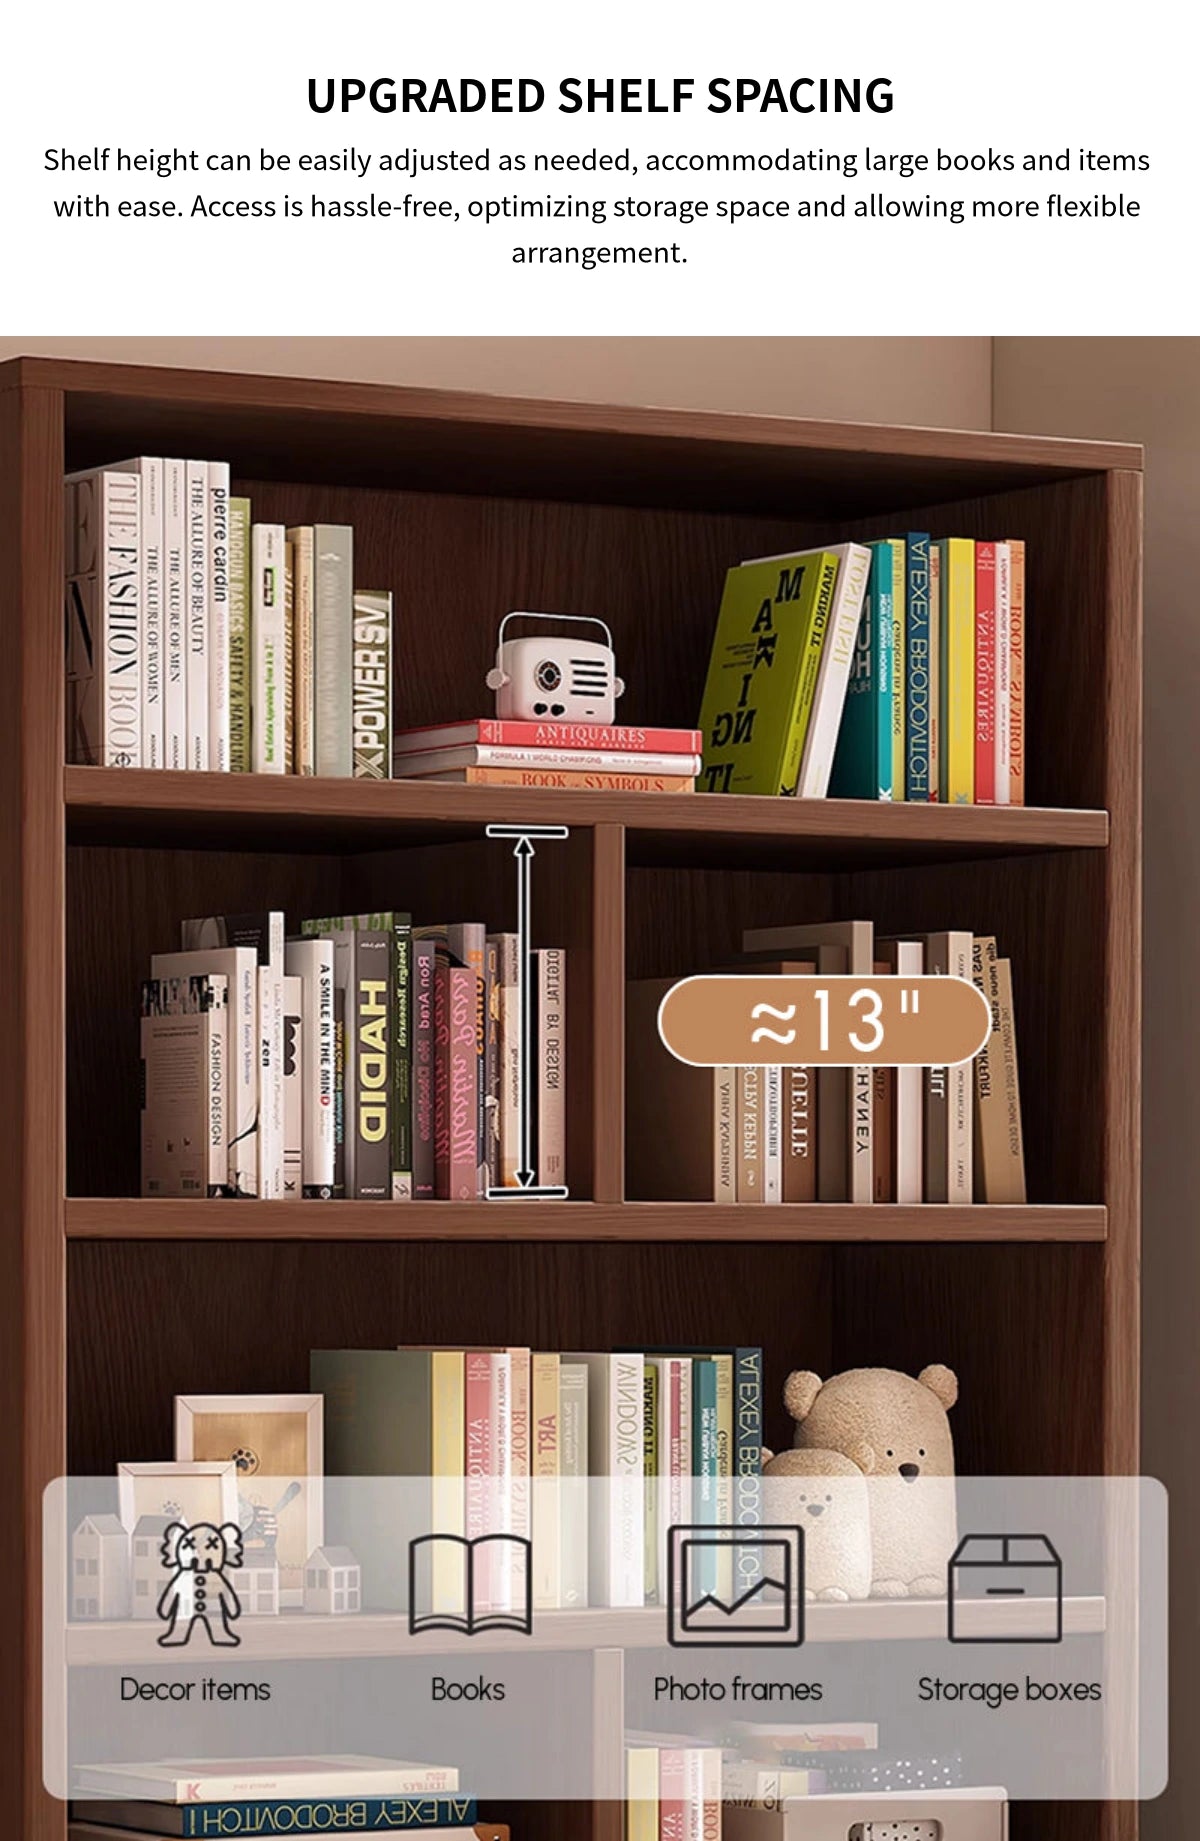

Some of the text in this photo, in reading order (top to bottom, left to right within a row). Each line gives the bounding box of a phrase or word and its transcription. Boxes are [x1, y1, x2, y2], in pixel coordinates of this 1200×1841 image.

[108, 477, 138, 538] THE
[191, 478, 204, 655] THE ALLURE OF BEAUTY
[212, 488, 228, 602] pierre cardin
[230, 511, 244, 581] HANDGUN
[108, 547, 138, 674] FASHION
[147, 546, 159, 704] THE ALLURE OF WOMEN
[169, 548, 181, 682] THE ALLURE OF MEN
[230, 584, 244, 633] BASICS
[230, 636, 244, 686] SAFETY
[490, 753, 525, 761] FORMULA
[533, 754, 559, 763] WORLD
[535, 725, 646, 743] ANTIQUAIRES
[522, 773, 665, 792] BOOK SYMBOLS
[262, 1039, 271, 1067] zen
[320, 964, 330, 1106] A SMILE IN THE MIND
[211, 1034, 222, 1146] FASHION DESIGN
[203, 1798, 470, 1832] ALEXEY BRODOVITCH
